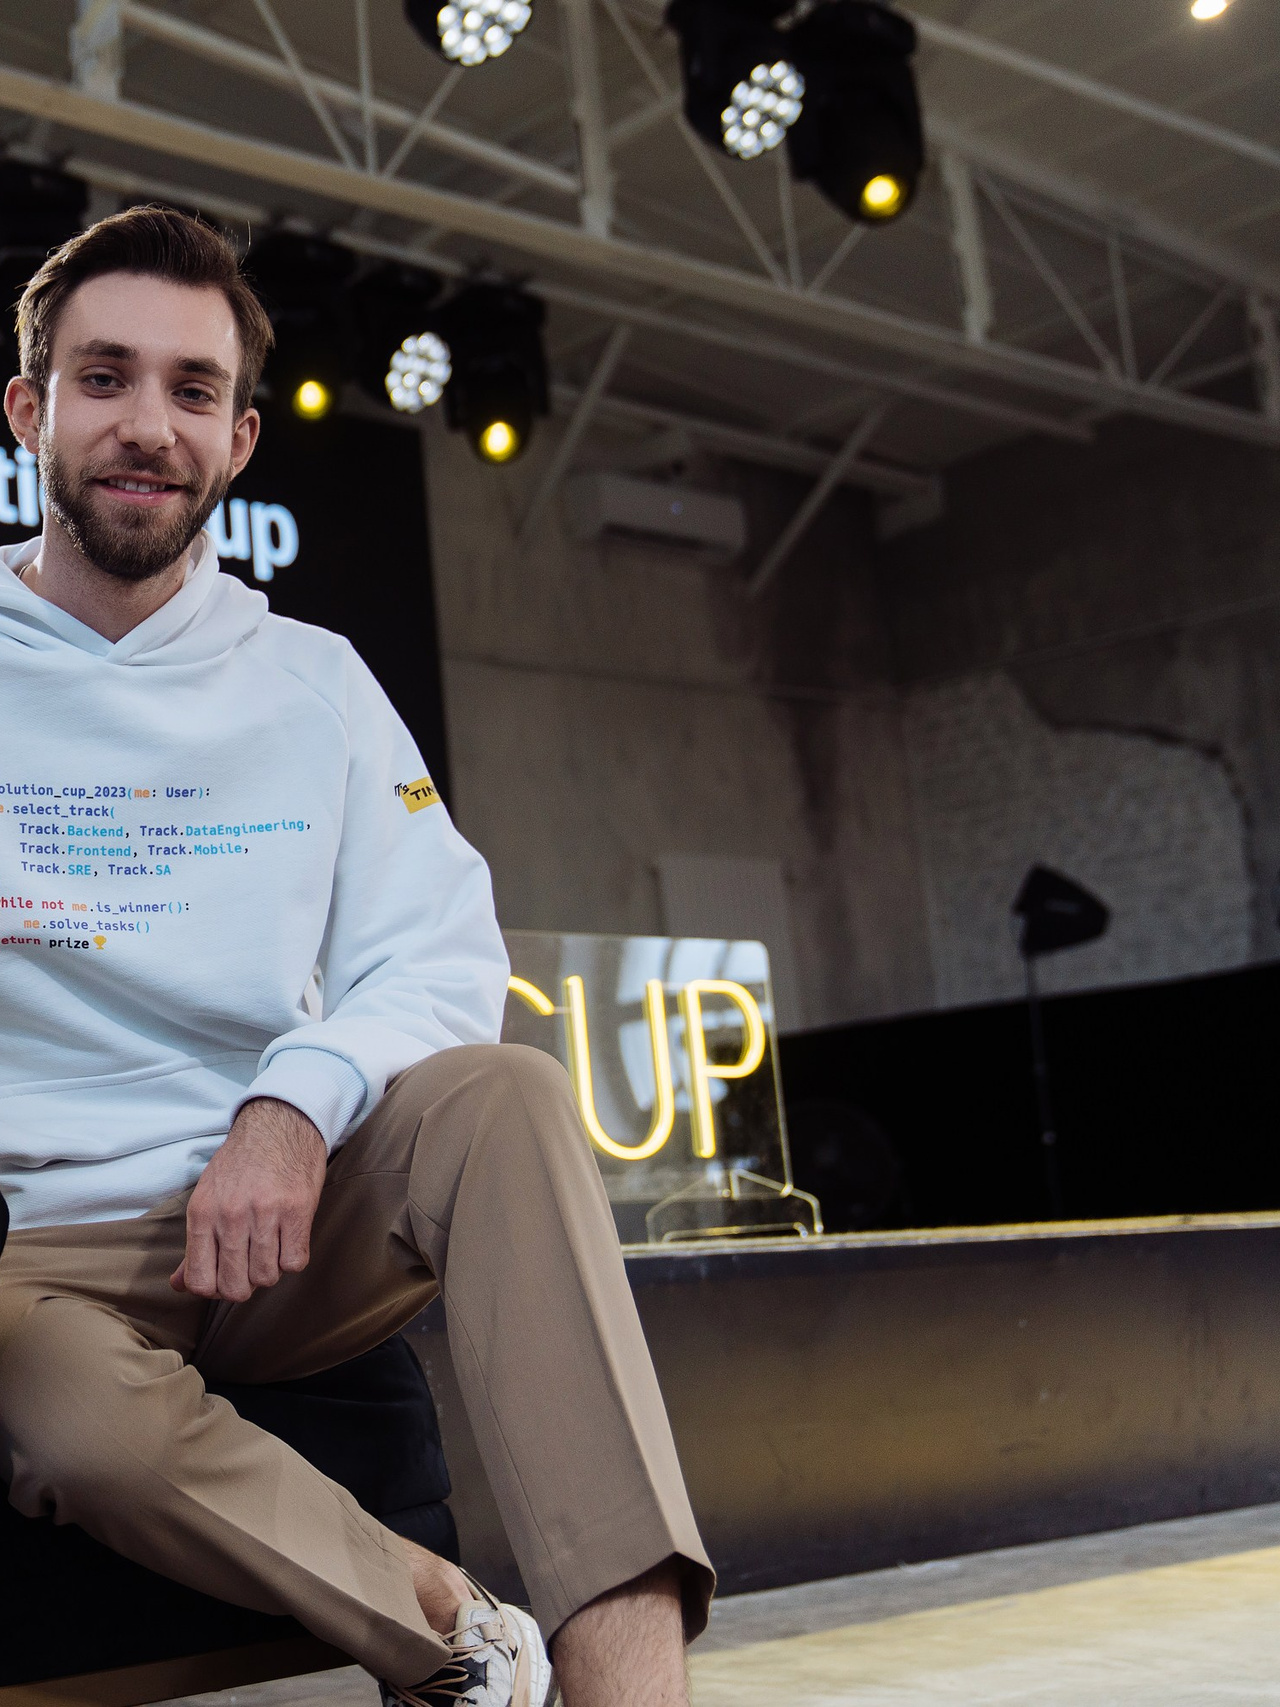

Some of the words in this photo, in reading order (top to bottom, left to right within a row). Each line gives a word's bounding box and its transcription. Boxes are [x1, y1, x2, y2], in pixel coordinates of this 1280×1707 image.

[201, 498, 300, 582] up
[166, 787, 210, 799] User):
[19, 823, 130, 838] Track.Backend,
[140, 819, 311, 837] Track.DataEngineering,
[19, 842, 138, 857] Track.Frontend,
[148, 843, 249, 856] Track.Mobile,
[21, 861, 98, 877] Track.SRE,
[108, 864, 172, 875] Track.SA
[42, 900, 65, 911] not
[72, 902, 190, 915] me.is_winner():
[23, 918, 151, 933] me.solve_tasks()
[49, 937, 90, 950] prize
[509, 974, 766, 1160] UP
